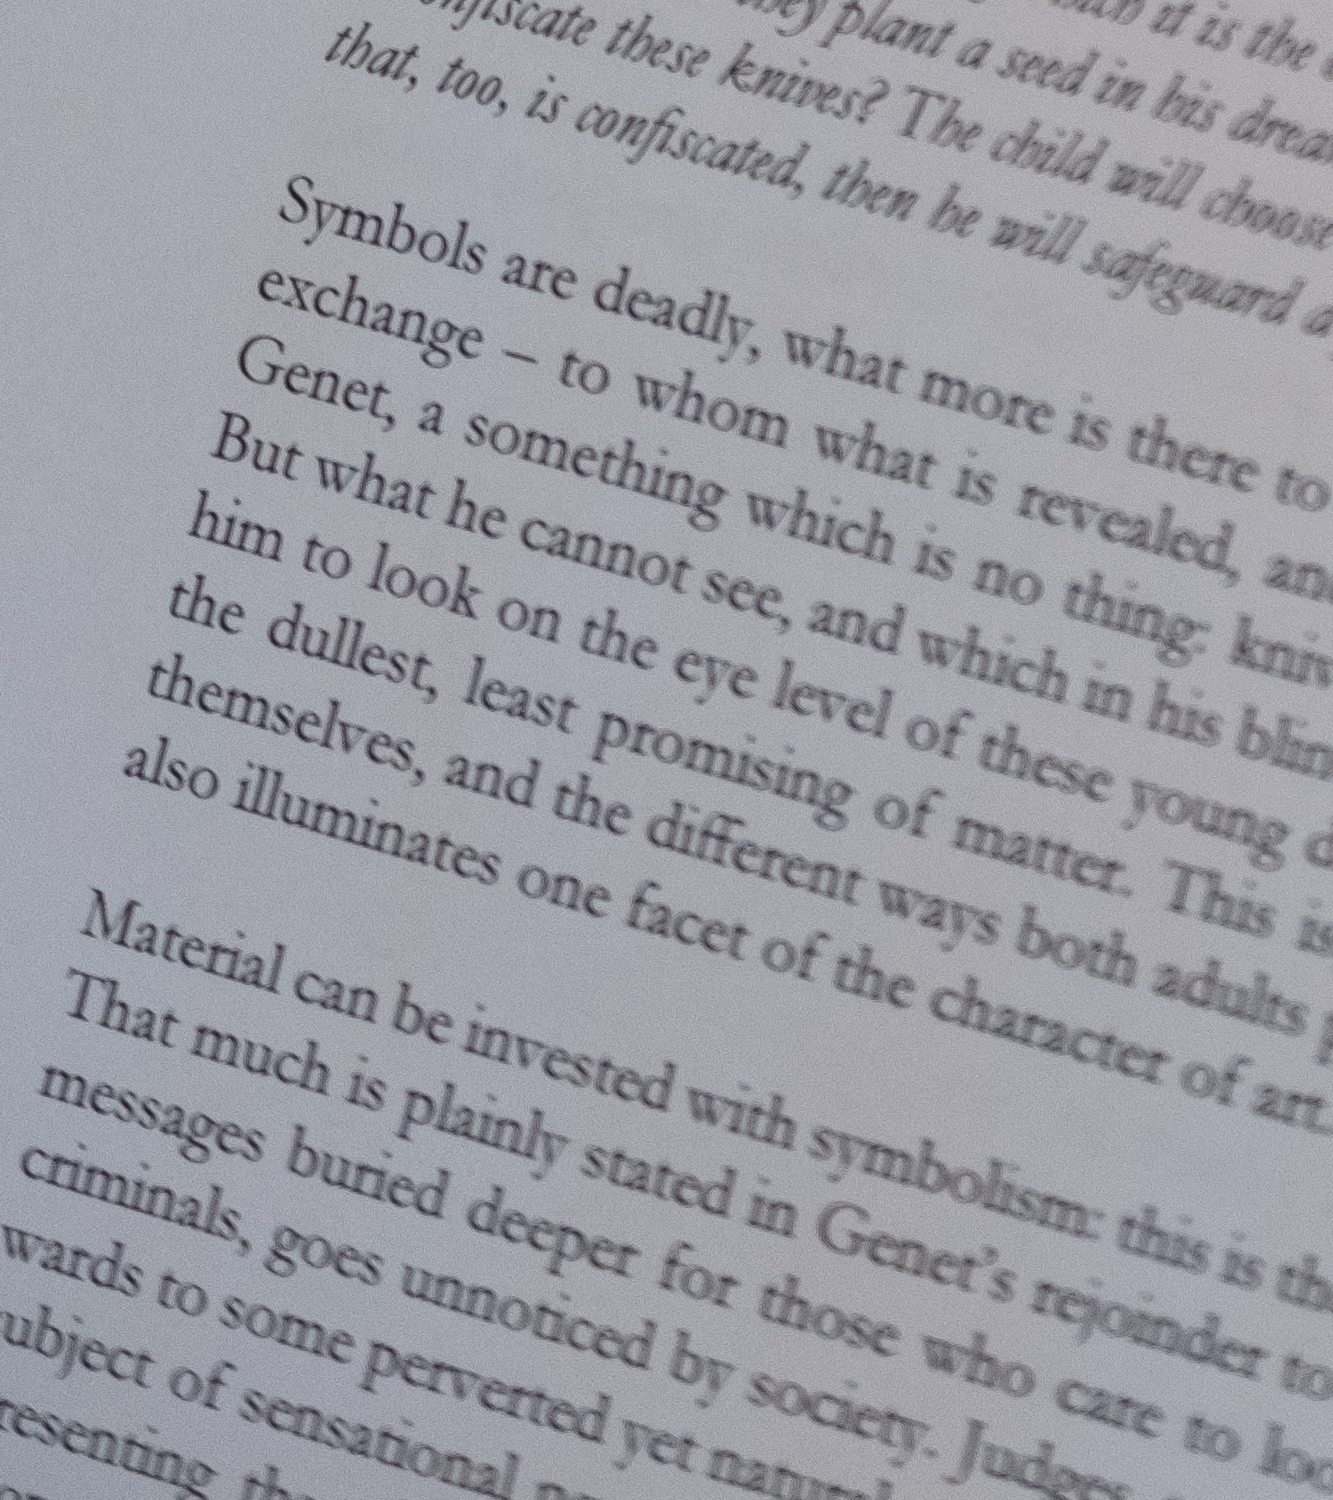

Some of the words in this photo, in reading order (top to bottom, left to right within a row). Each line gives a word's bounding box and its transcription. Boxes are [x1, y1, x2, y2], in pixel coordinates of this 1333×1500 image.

[276, 173, 489, 277] Symbols
[498, 251, 580, 303] are
[590, 262, 763, 367] deadly,
[781, 322, 910, 396] what
[209, 408, 306, 483] But
[314, 448, 438, 522] what
[442, 475, 510, 542] he
[517, 516, 695, 596] cannot
[120, 733, 222, 802] also
[229, 759, 504, 888] illuminates
[514, 863, 614, 921] one
[78, 885, 289, 997] Material
[291, 969, 381, 1026] can
[389, 978, 456, 1047] be
[459, 1001, 680, 1115] invested
[17, 1140, 254, 1259] criminals,
[261, 1223, 386, 1288] goes
[399, 1261, 660, 1373] unnoticed
